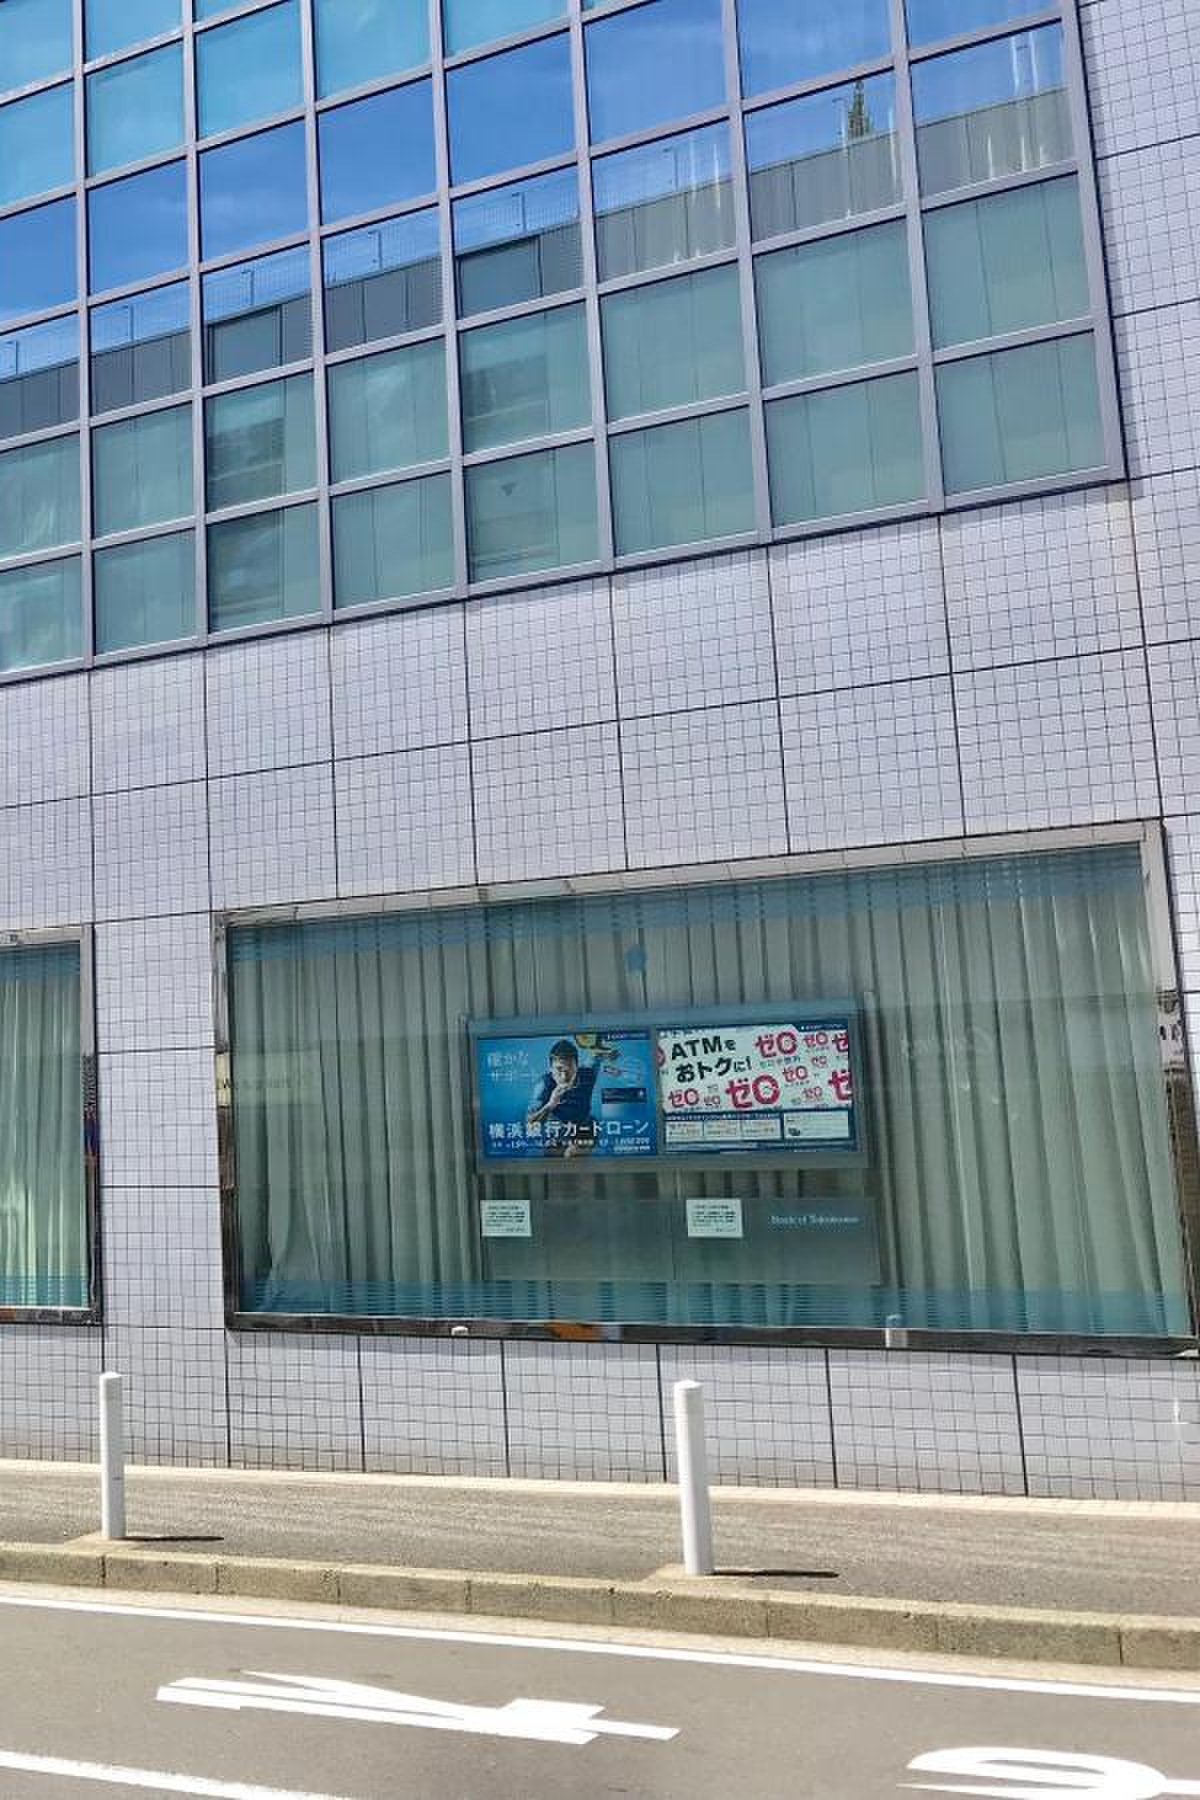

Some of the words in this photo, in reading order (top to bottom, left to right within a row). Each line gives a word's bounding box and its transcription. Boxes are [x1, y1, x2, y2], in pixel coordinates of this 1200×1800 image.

[489, 1120, 649, 1138] 横浜銀行カードローン
